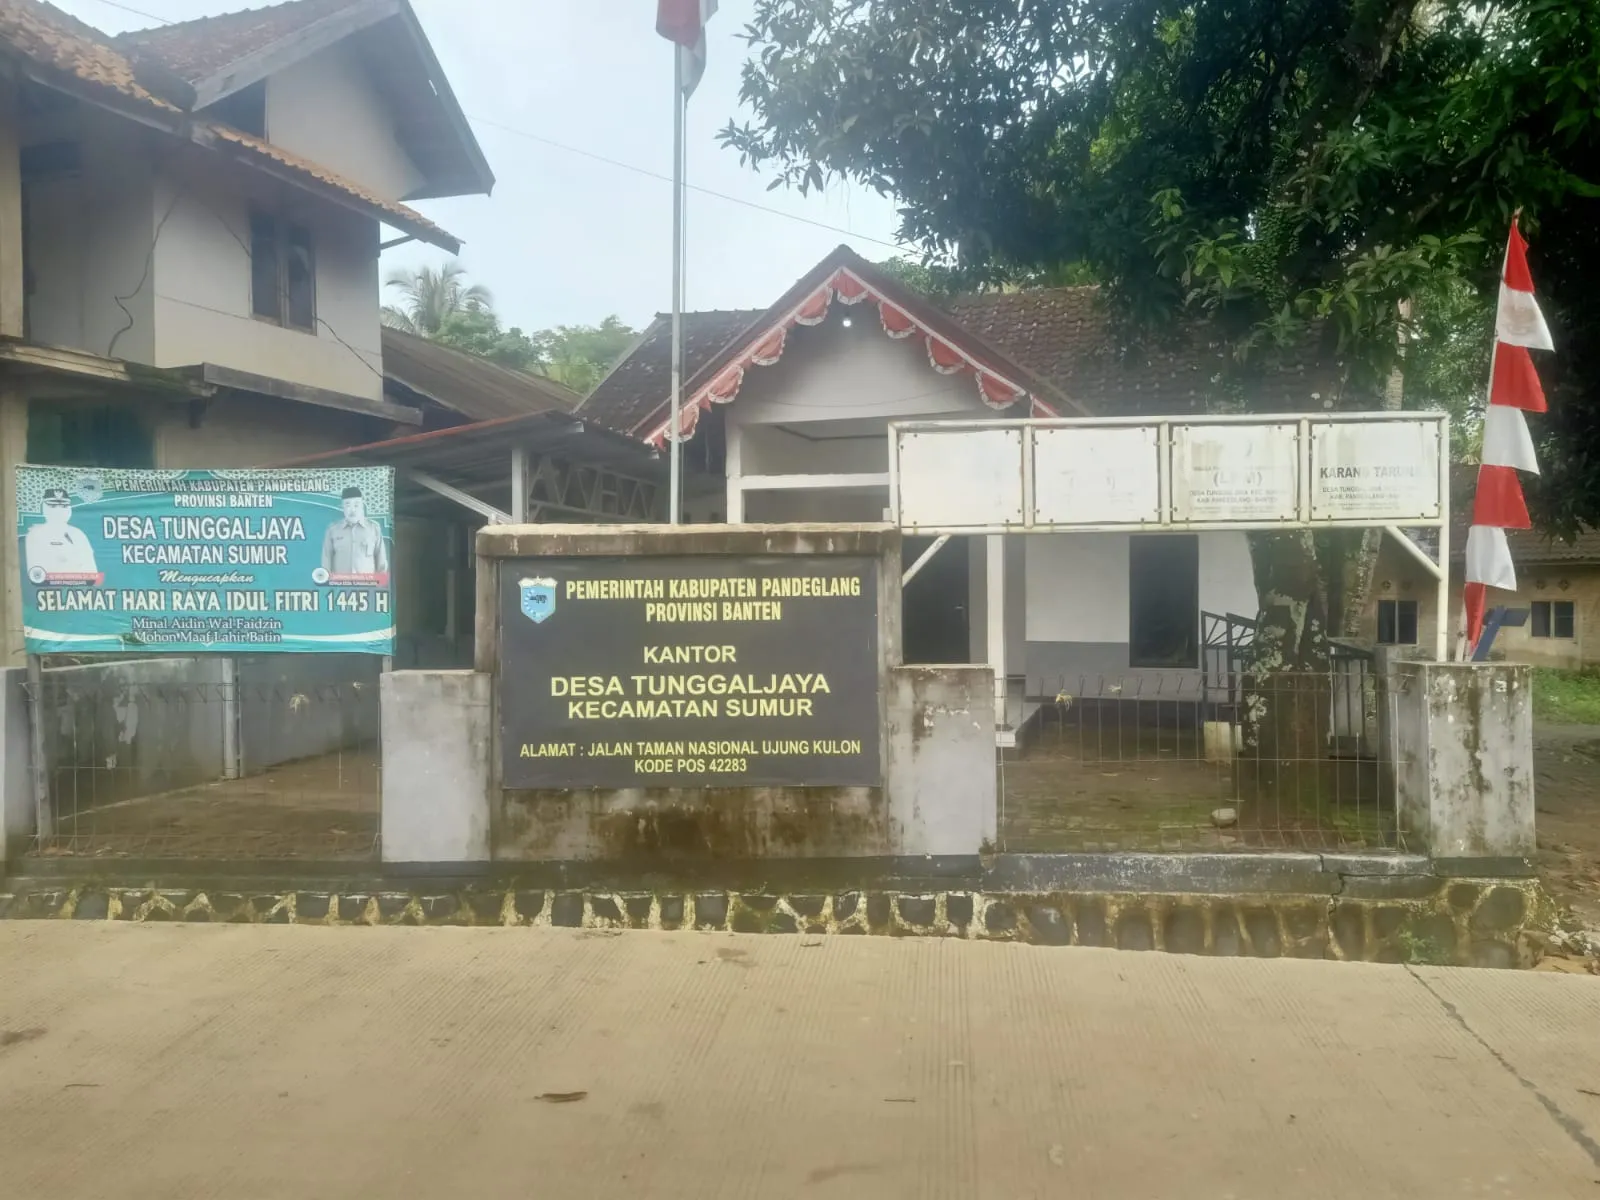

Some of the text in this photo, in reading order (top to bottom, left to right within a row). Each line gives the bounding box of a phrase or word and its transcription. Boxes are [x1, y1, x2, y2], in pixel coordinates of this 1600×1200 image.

[1320, 466, 1369, 478] KARAN
[115, 480, 330, 492] PEMERINTAH KABUPATEN PANDEGLANG
[174, 494, 273, 508] PROVINSI BANTEN
[103, 516, 306, 540] DESA TUNGGALJAYA
[122, 544, 288, 564] KECAMATAN SUMUR
[159, 569, 254, 586] Mengucapkan
[565, 577, 861, 600] PEMERINTAH KABUPATEN PANDEGLANG
[37, 590, 388, 612] SELAMAT HARI RAYA IDUL FITRI 1445 H
[645, 601, 782, 623] PROVINSI BANTEN
[132, 617, 282, 629] Minal Aidin Wal Faidzin
[135, 630, 281, 644] Mohon Maaf Lahir Batin
[643, 645, 737, 664] KANTOR
[551, 673, 831, 697] DESA TUNGGALJAYA
[568, 698, 814, 719] KECAMATAN SUMUR
[519, 743, 577, 757] ALAMAT
[587, 742, 633, 756] JALAN
[636, 741, 684, 756] TAMAN
[688, 741, 759, 755] NASIONAL
[762, 740, 810, 755] UJUNG
[812, 739, 861, 755] KULON
[634, 758, 748, 773] KODE POS 42283
